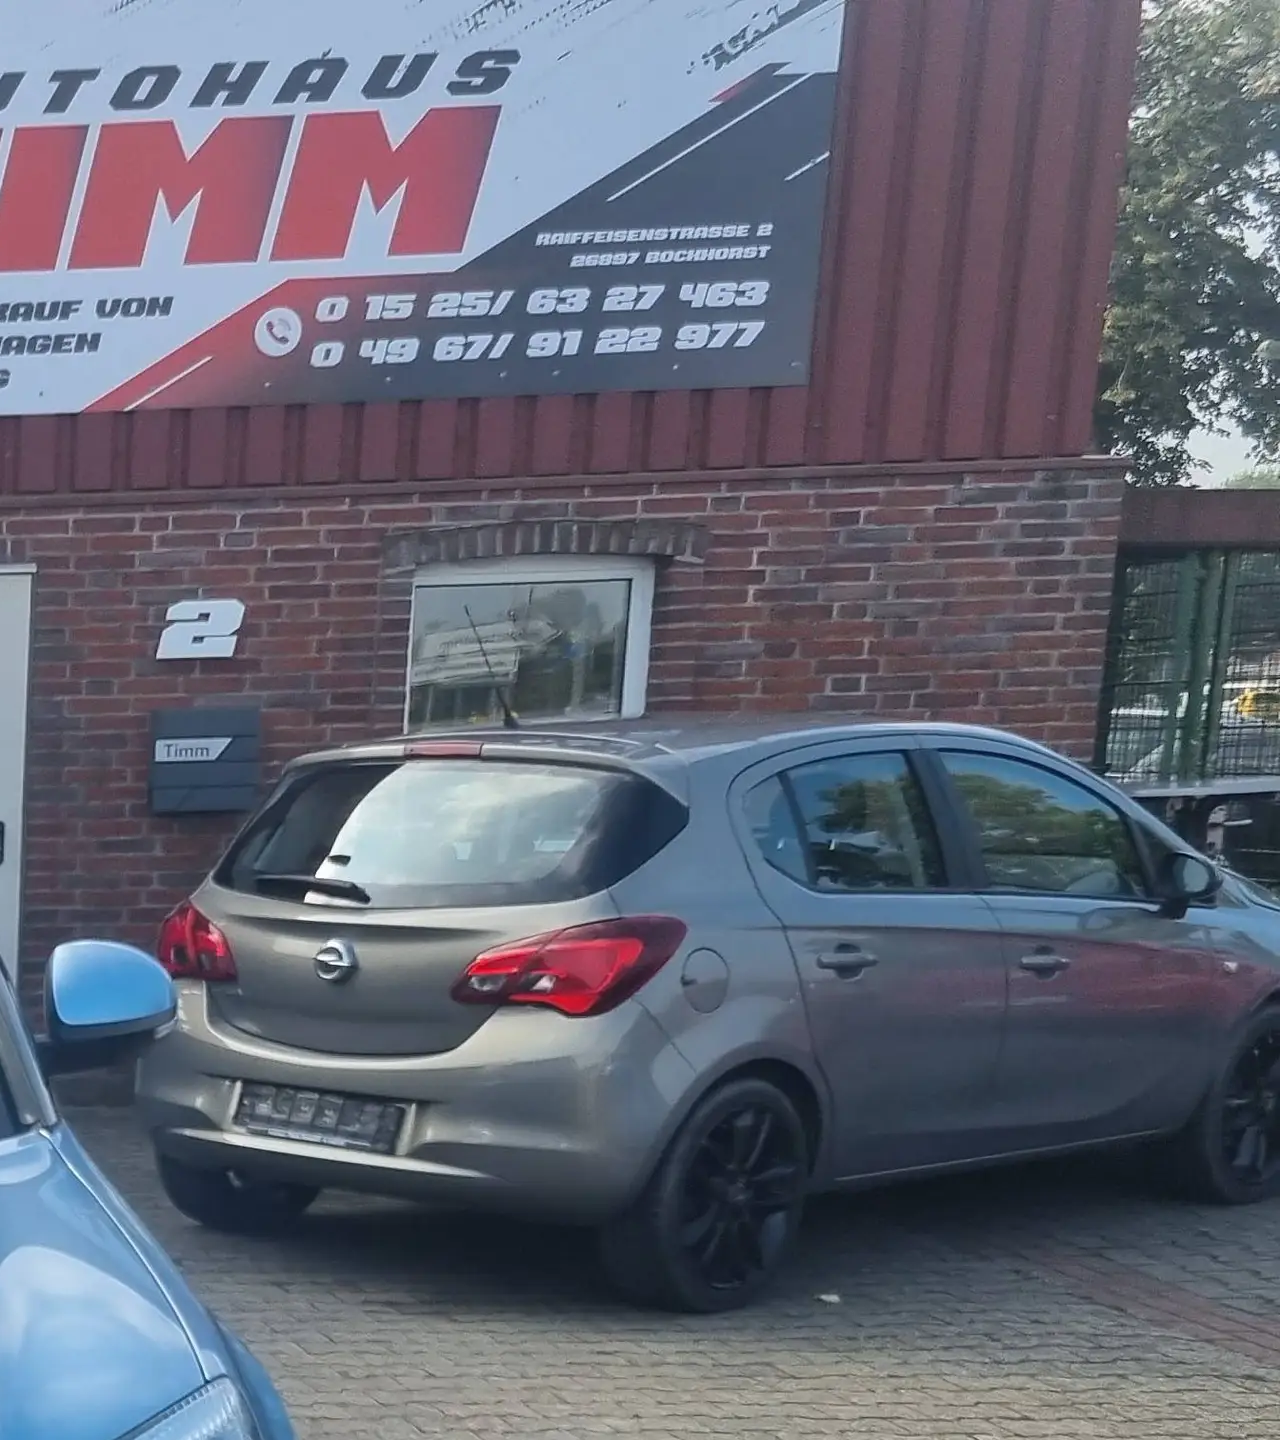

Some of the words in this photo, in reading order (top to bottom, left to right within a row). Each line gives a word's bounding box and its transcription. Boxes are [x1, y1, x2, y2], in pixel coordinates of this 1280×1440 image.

[535, 224, 751, 246] RAIFFEISENSTRASSE
[756, 222, 773, 237] 2
[95, 296, 175, 319] VON
[315, 296, 349, 322] 0
[365, 293, 417, 320] 15
[426, 289, 515, 318] 25/
[526, 286, 590, 315] 63
[602, 284, 665, 312] 27
[678, 280, 770, 308] 463
[310, 341, 344, 368] 0
[359, 337, 421, 364] 49
[433, 333, 515, 361] 67/
[526, 329, 584, 358] 91
[593, 326, 663, 355] 22
[674, 321, 766, 350] 977
[155, 599, 245, 660] 2
[163, 743, 210, 758] Timm
